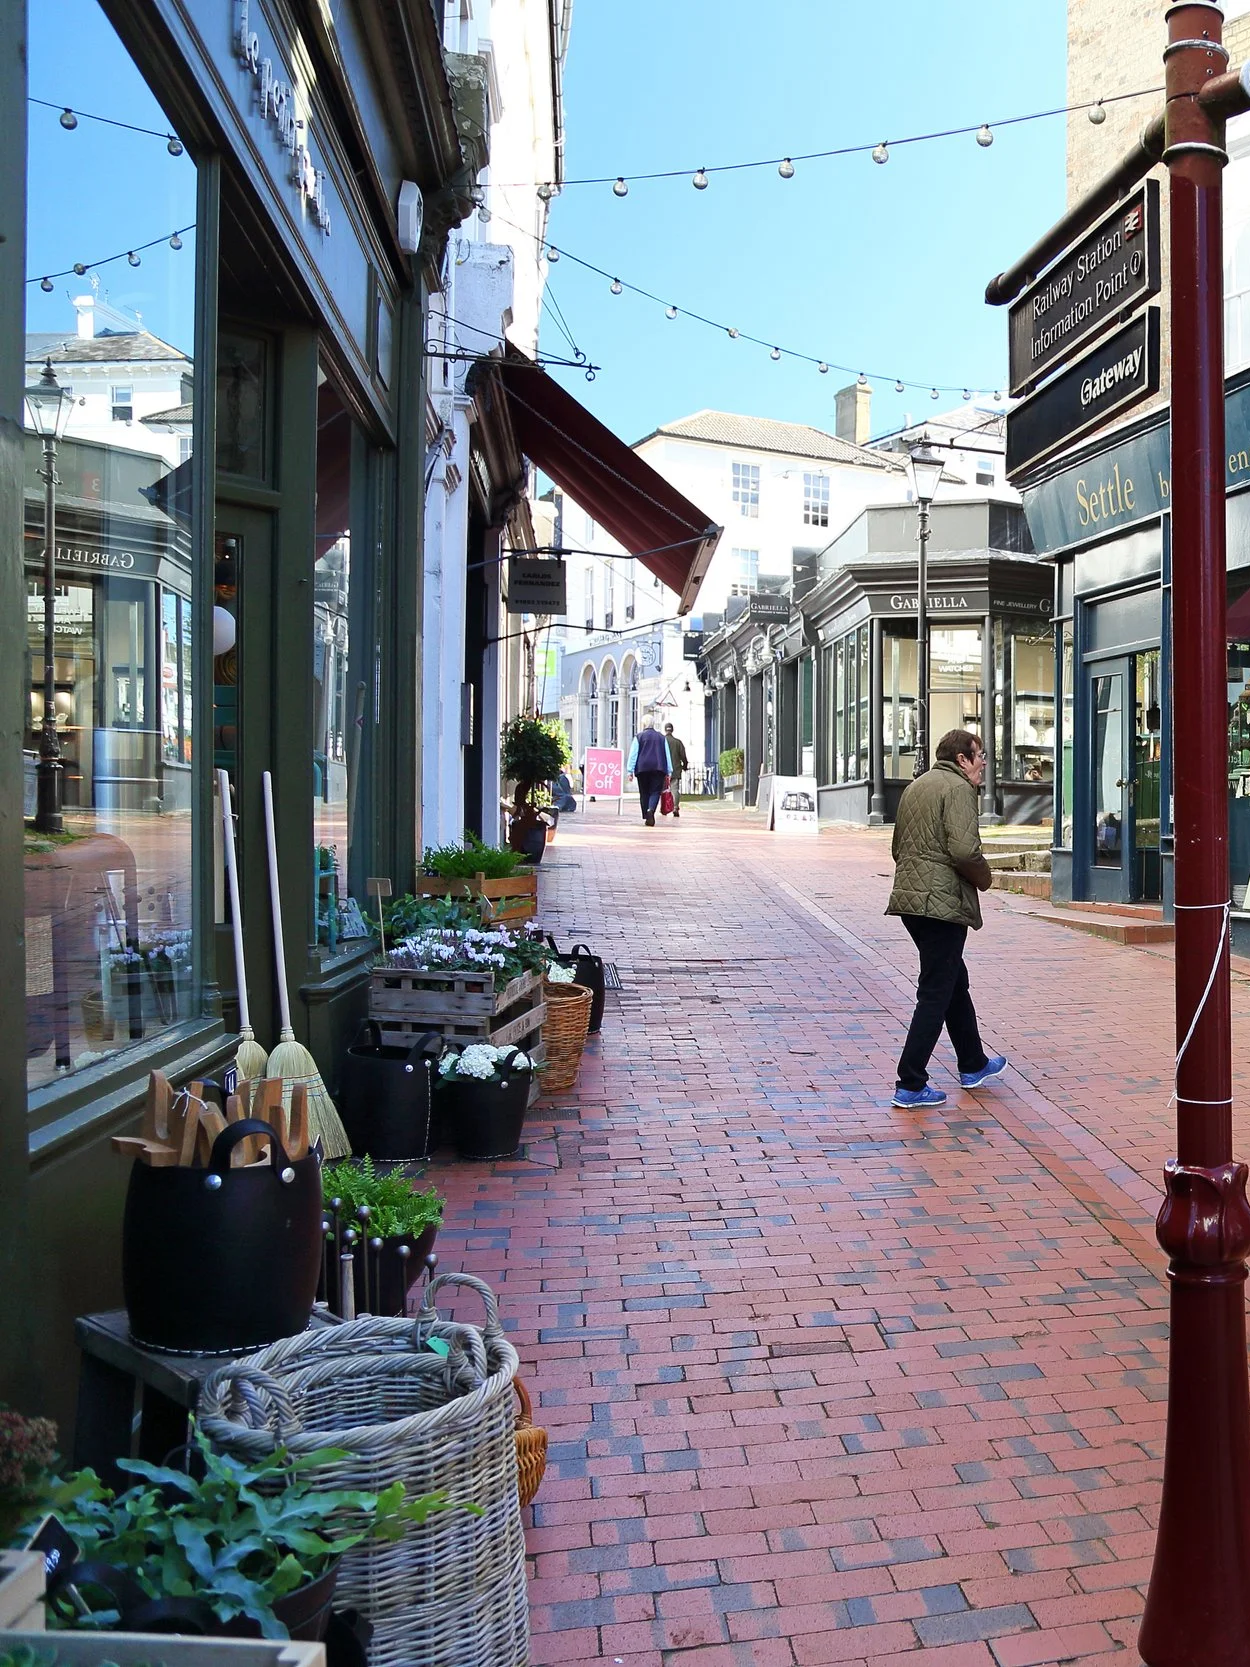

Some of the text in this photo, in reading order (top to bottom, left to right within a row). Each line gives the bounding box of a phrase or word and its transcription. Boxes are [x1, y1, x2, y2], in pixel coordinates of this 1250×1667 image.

[1032, 230, 1122, 321] Railway Station
[1031, 265, 1129, 360] Information Point
[1080, 346, 1142, 405] Gateway
[1076, 463, 1136, 526] Settle
[751, 602, 788, 611] GABRIELLA
[890, 595, 968, 610] GABIELLA
[589, 762, 620, 776] 70%
[595, 775, 613, 789] off
